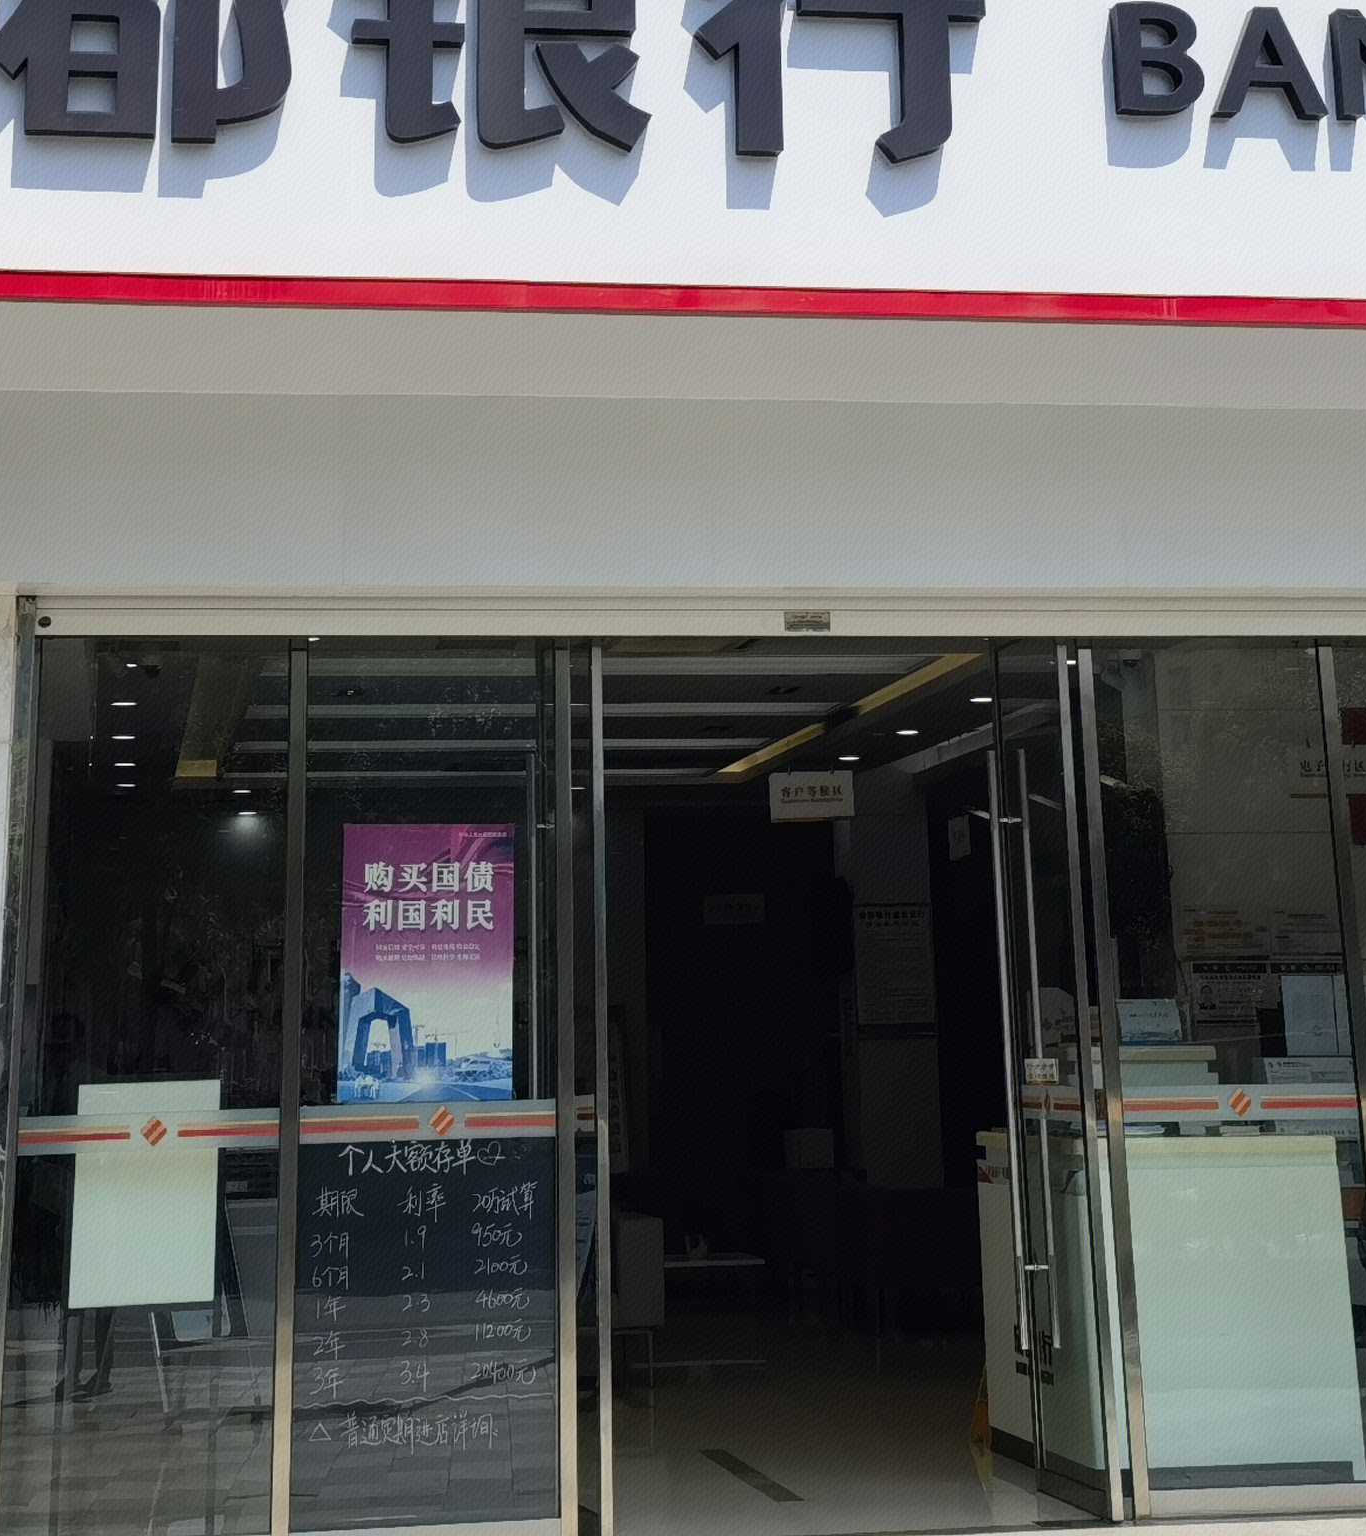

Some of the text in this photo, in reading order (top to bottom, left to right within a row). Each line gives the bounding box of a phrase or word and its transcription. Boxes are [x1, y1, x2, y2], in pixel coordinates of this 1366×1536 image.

[363, 861, 495, 894] 购买国债
[362, 899, 495, 932] 利国利民
[339, 1139, 476, 1175] 个人大额存单
[311, 1181, 537, 1223] 期限 利率 20万试算
[310, 1222, 522, 1260] 3个月 1.9 950元
[311, 1254, 527, 1290] 6个月 2.1 2100元
[316, 1287, 529, 1322] 1年 2.3 4600元
[312, 1318, 531, 1361] 2年 2.8 11200元
[310, 1358, 536, 1399] 3年 3.4 20400元
